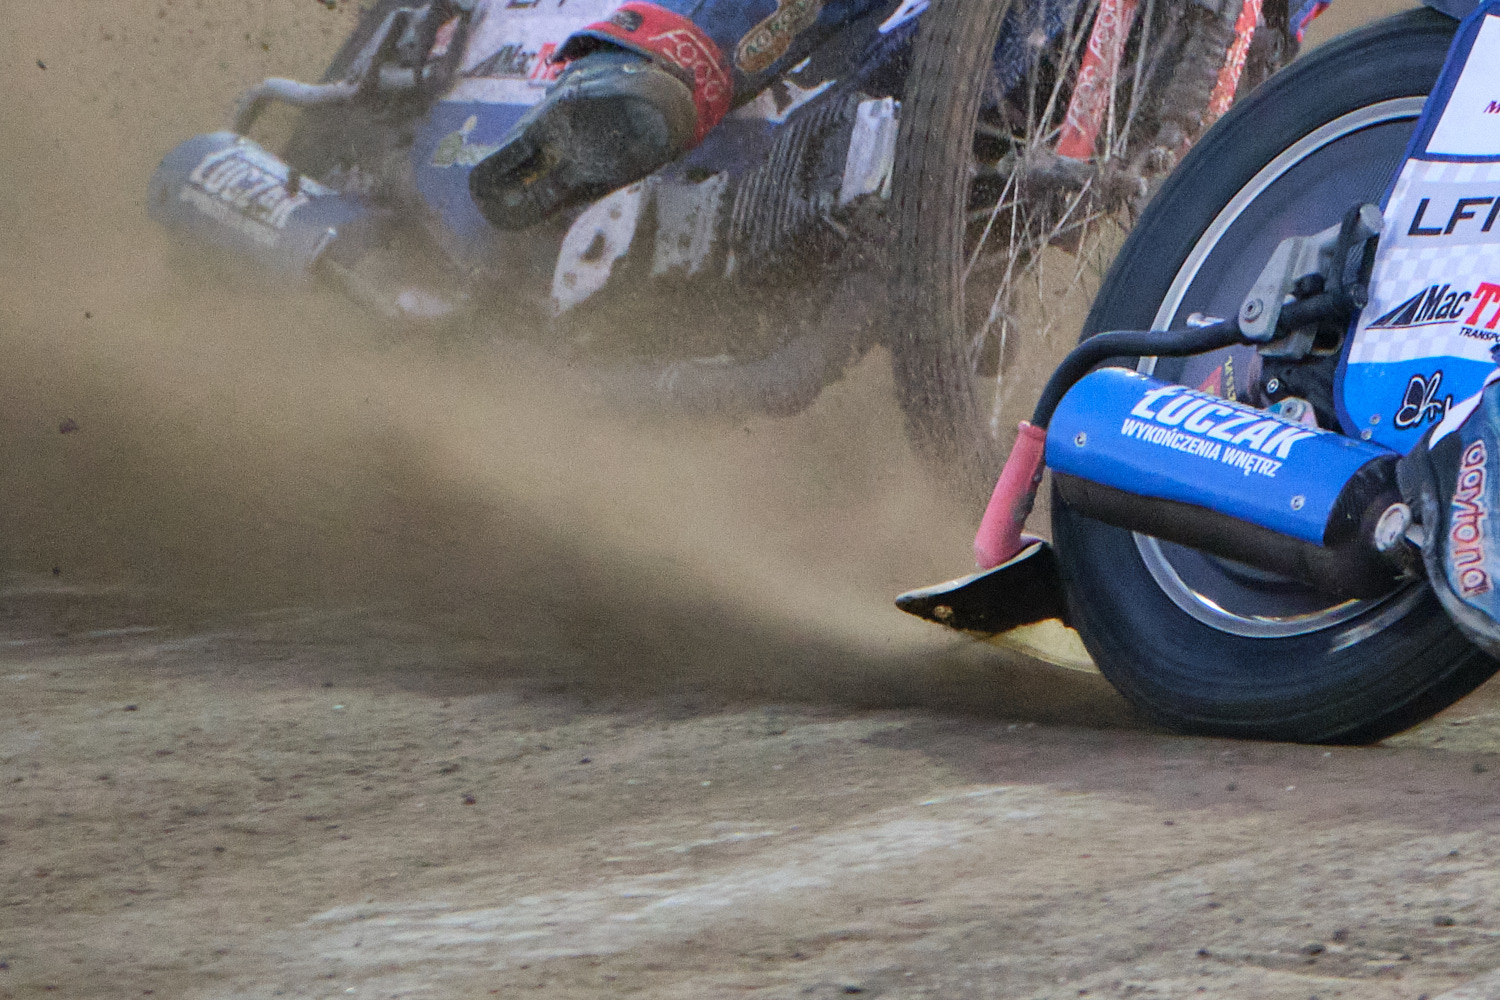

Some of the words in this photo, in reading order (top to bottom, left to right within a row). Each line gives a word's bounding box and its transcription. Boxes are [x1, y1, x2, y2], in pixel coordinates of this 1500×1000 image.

[1121, 418, 1222, 460] WYKOŃCZENIA
[1222, 447, 1283, 477] WNĘTRZ
[1453, 440, 1491, 598] daytona
